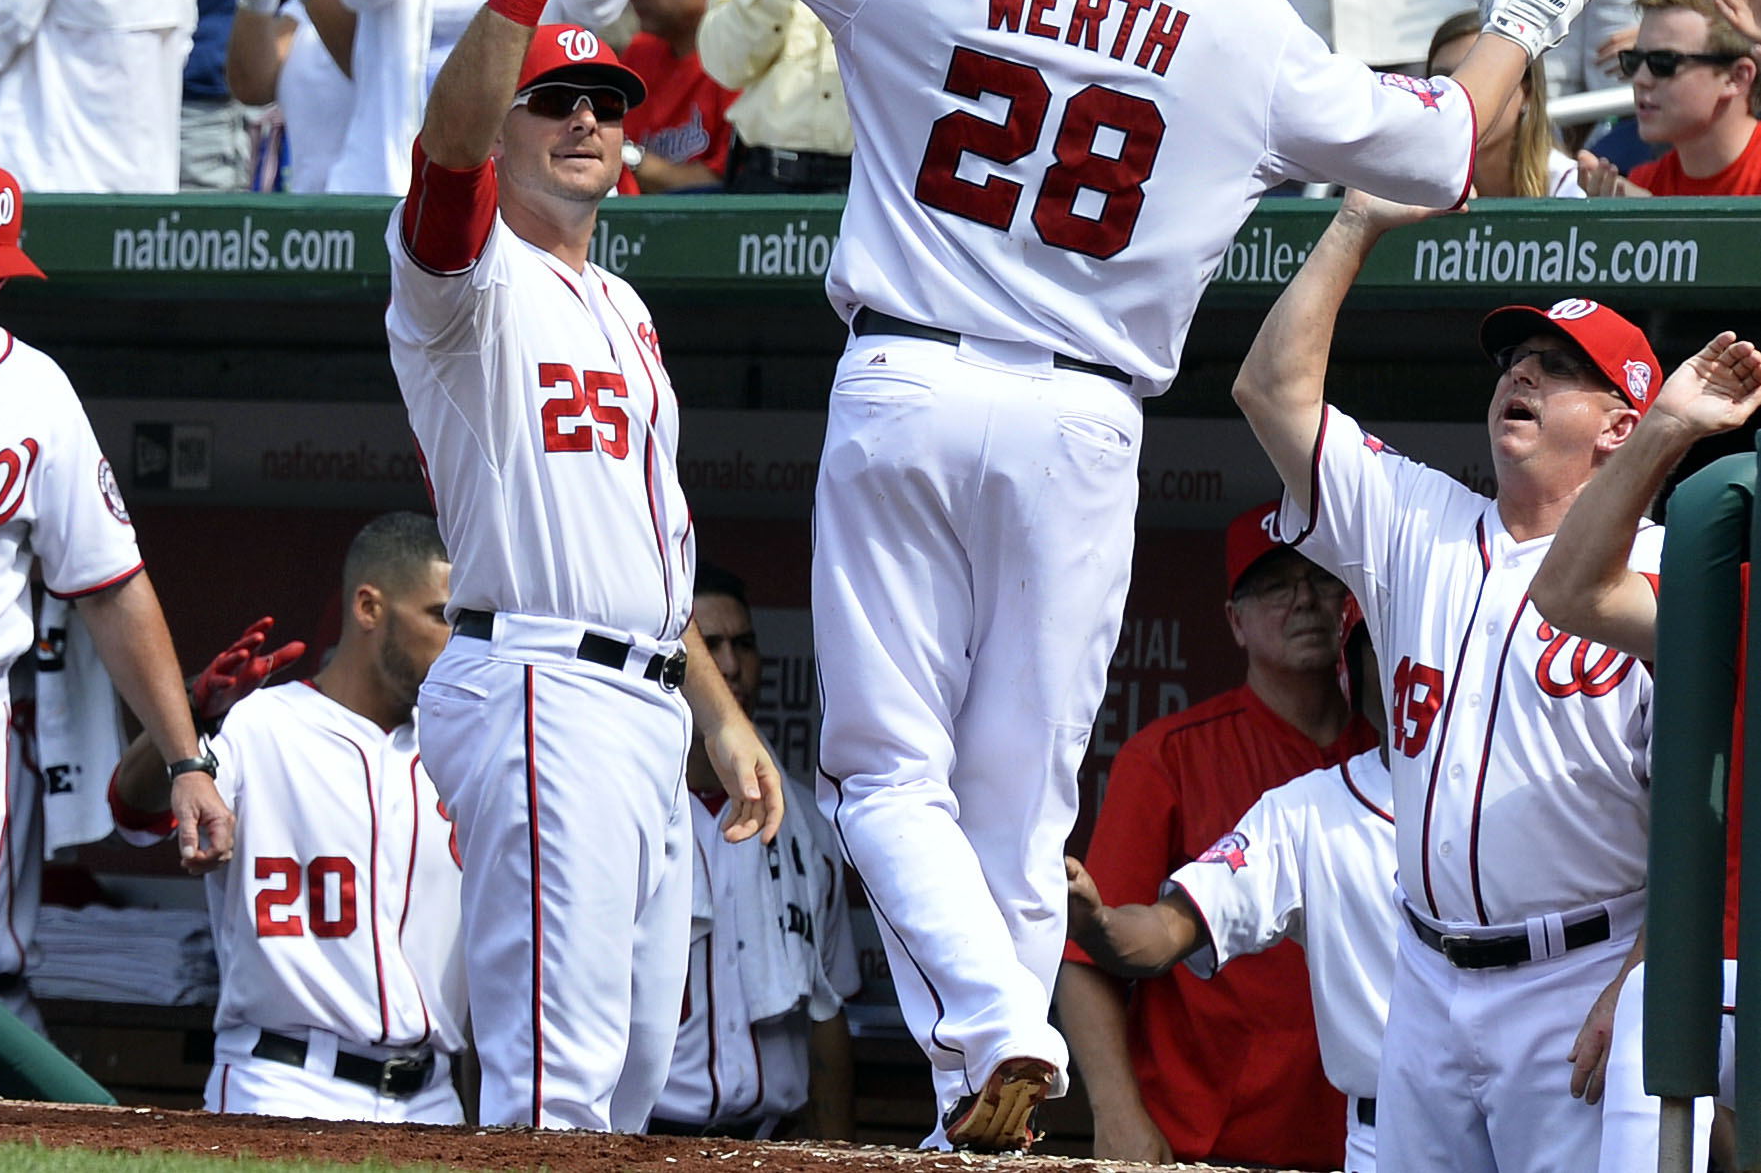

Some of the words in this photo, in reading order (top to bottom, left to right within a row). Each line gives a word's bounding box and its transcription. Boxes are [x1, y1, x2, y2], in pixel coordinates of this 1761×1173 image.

[915, 46, 1167, 260] 28
[113, 211, 355, 271] nationals.com
[738, 220, 840, 275] natio
[1414, 226, 1699, 283] nationals.com
[538, 362, 630, 461] 25
[254, 856, 358, 938] 20
